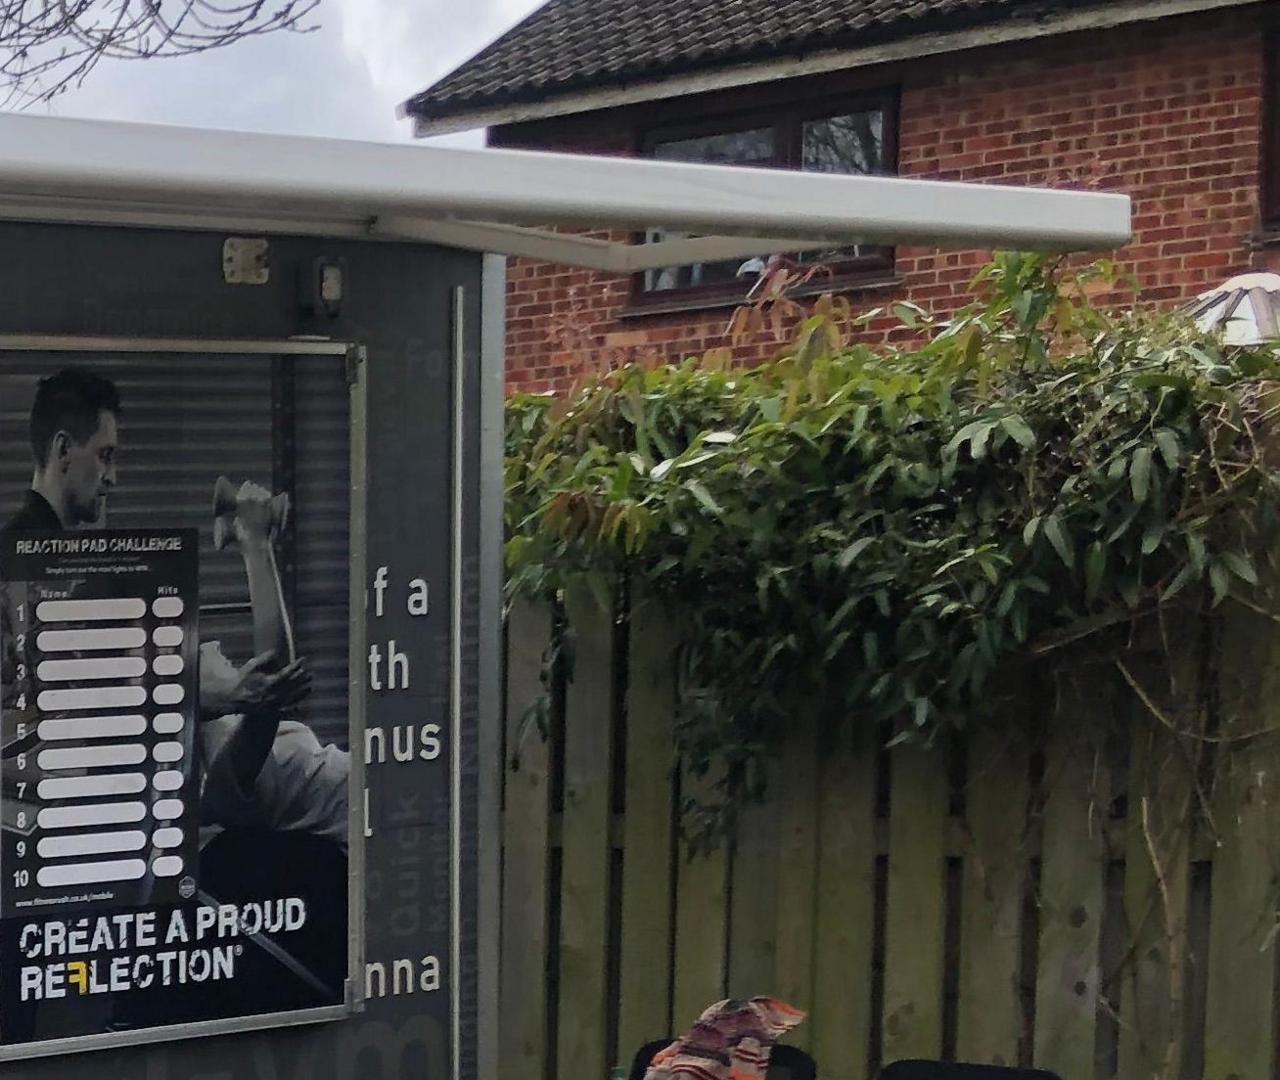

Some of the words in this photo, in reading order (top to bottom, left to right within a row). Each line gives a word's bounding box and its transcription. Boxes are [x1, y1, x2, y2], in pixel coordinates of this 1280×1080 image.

[16, 540, 79, 554] REACTION
[81, 539, 107, 552] PAD
[109, 536, 183, 552] CHALLENGE
[406, 576, 429, 617] a
[17, 605, 24, 621] 1
[17, 634, 25, 651] 2
[17, 663, 26, 681] 3
[368, 640, 410, 692] th
[16, 693, 27, 710] 4
[17, 723, 26, 740] 5
[364, 720, 441, 766] nus
[17, 752, 26, 770] 6
[16, 782, 26, 799] 7
[17, 812, 26, 829] 8
[17, 841, 26, 858] 9
[13, 870, 29, 888] 10
[18, 911, 156, 959] CREATE
[164, 909, 189, 944] A
[195, 897, 307, 941] PROUD
[364, 953, 440, 1000] nna
